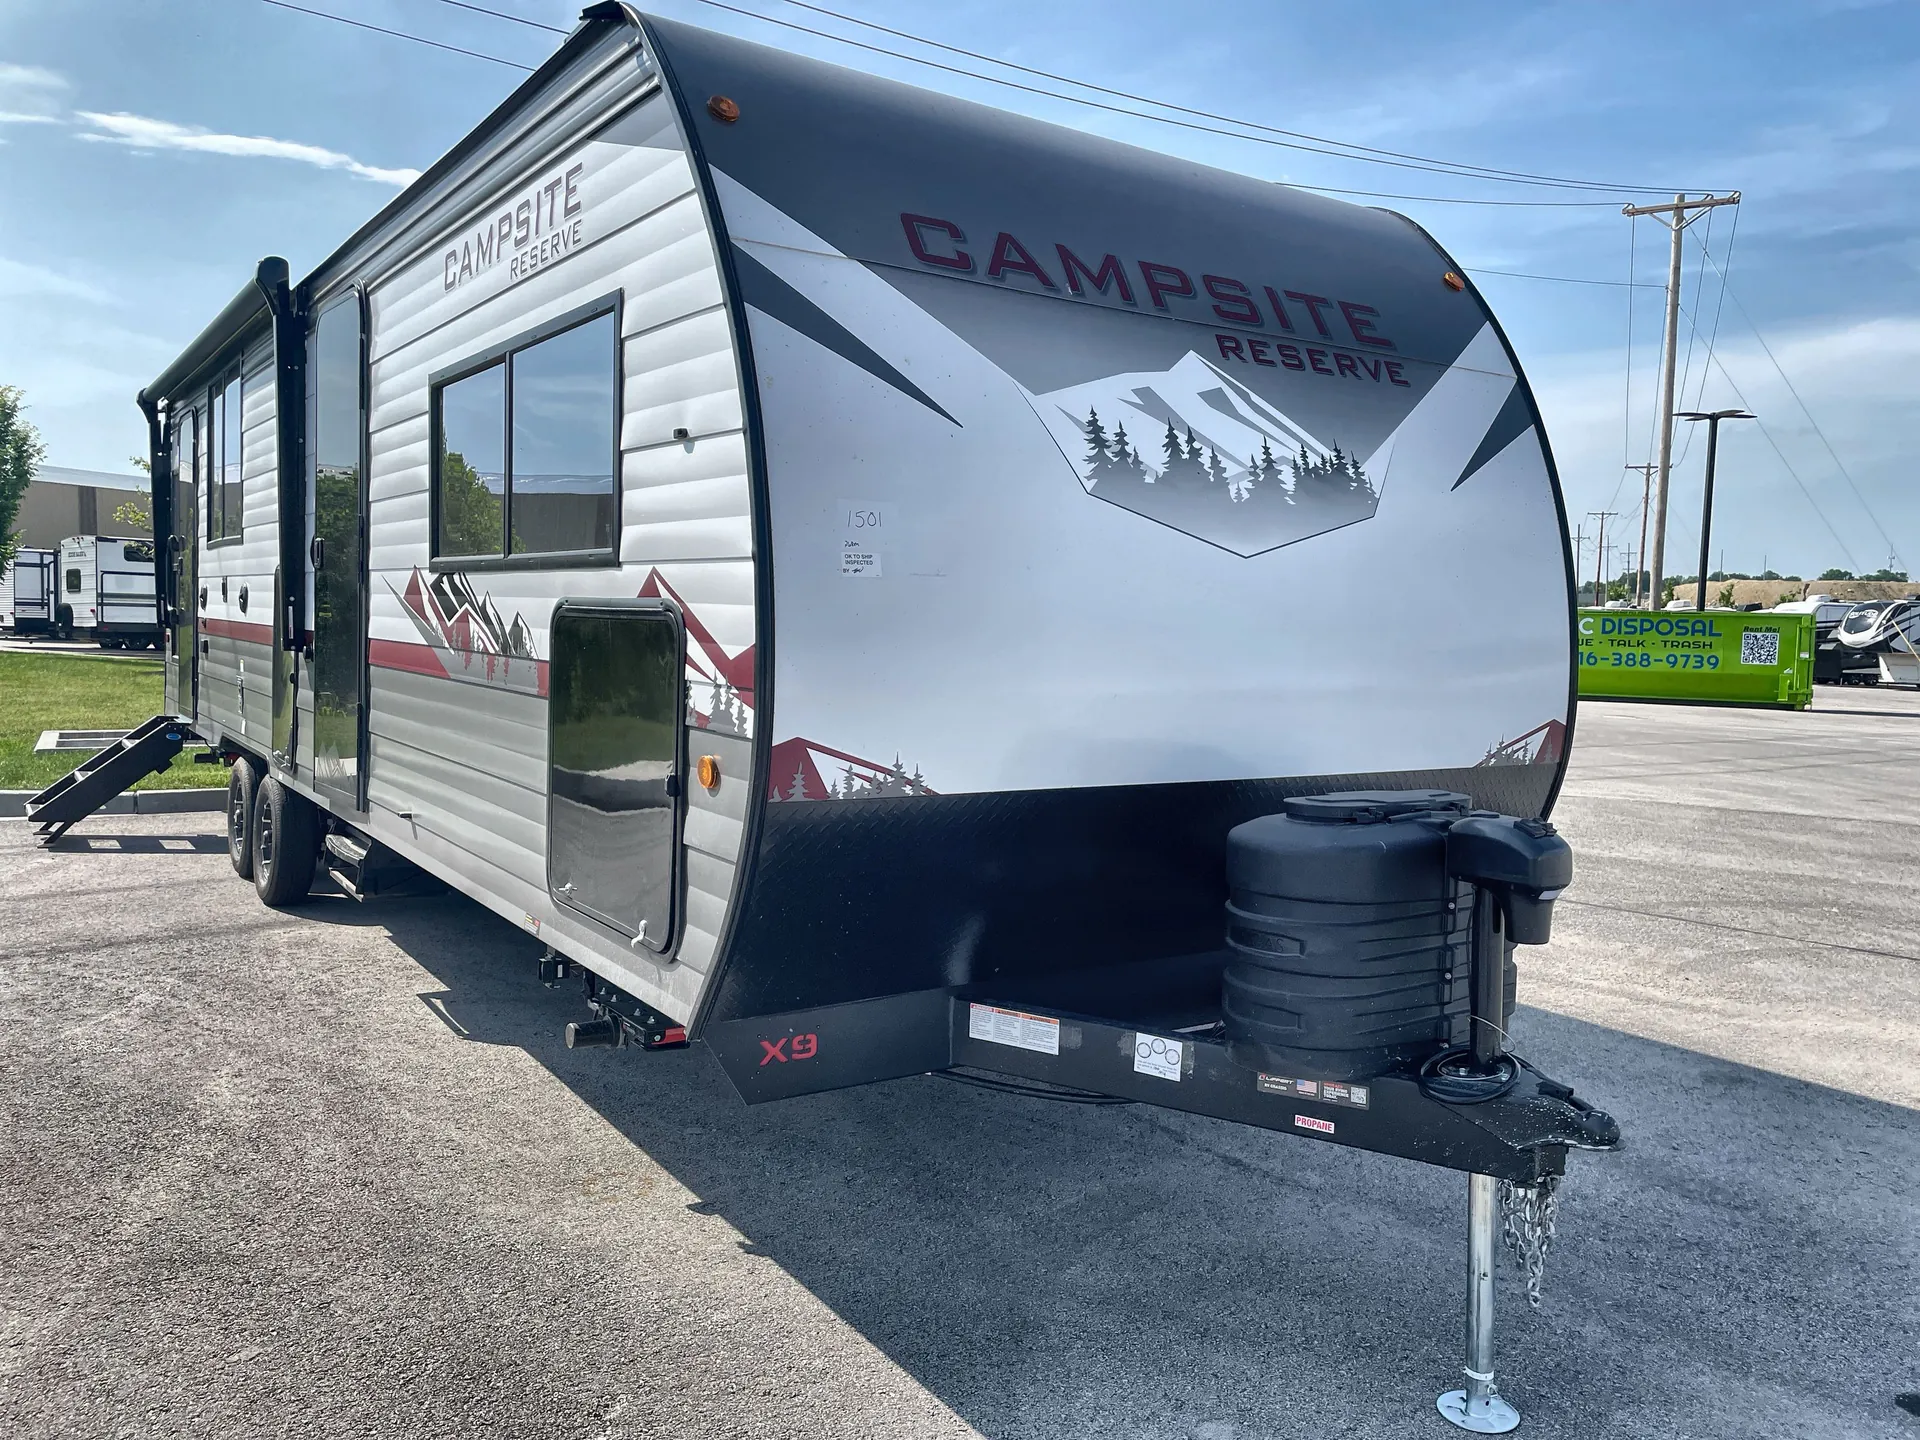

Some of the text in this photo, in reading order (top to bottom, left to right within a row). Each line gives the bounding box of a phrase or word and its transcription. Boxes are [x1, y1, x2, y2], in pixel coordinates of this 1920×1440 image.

[445, 161, 583, 292] CAMPSITE
[510, 218, 582, 280] RESERVE
[900, 212, 1397, 348] CAMPSITE
[1214, 333, 1411, 388] RESERVE
[847, 510, 882, 528] 1501
[1601, 617, 1723, 638] DISPOSAL
[1743, 625, 1762, 633] Rent
[1608, 638, 1646, 648] TALK
[1661, 639, 1713, 650] TRASH
[760, 1033, 818, 1067] X9
[1296, 1116, 1333, 1132] PROPANE
